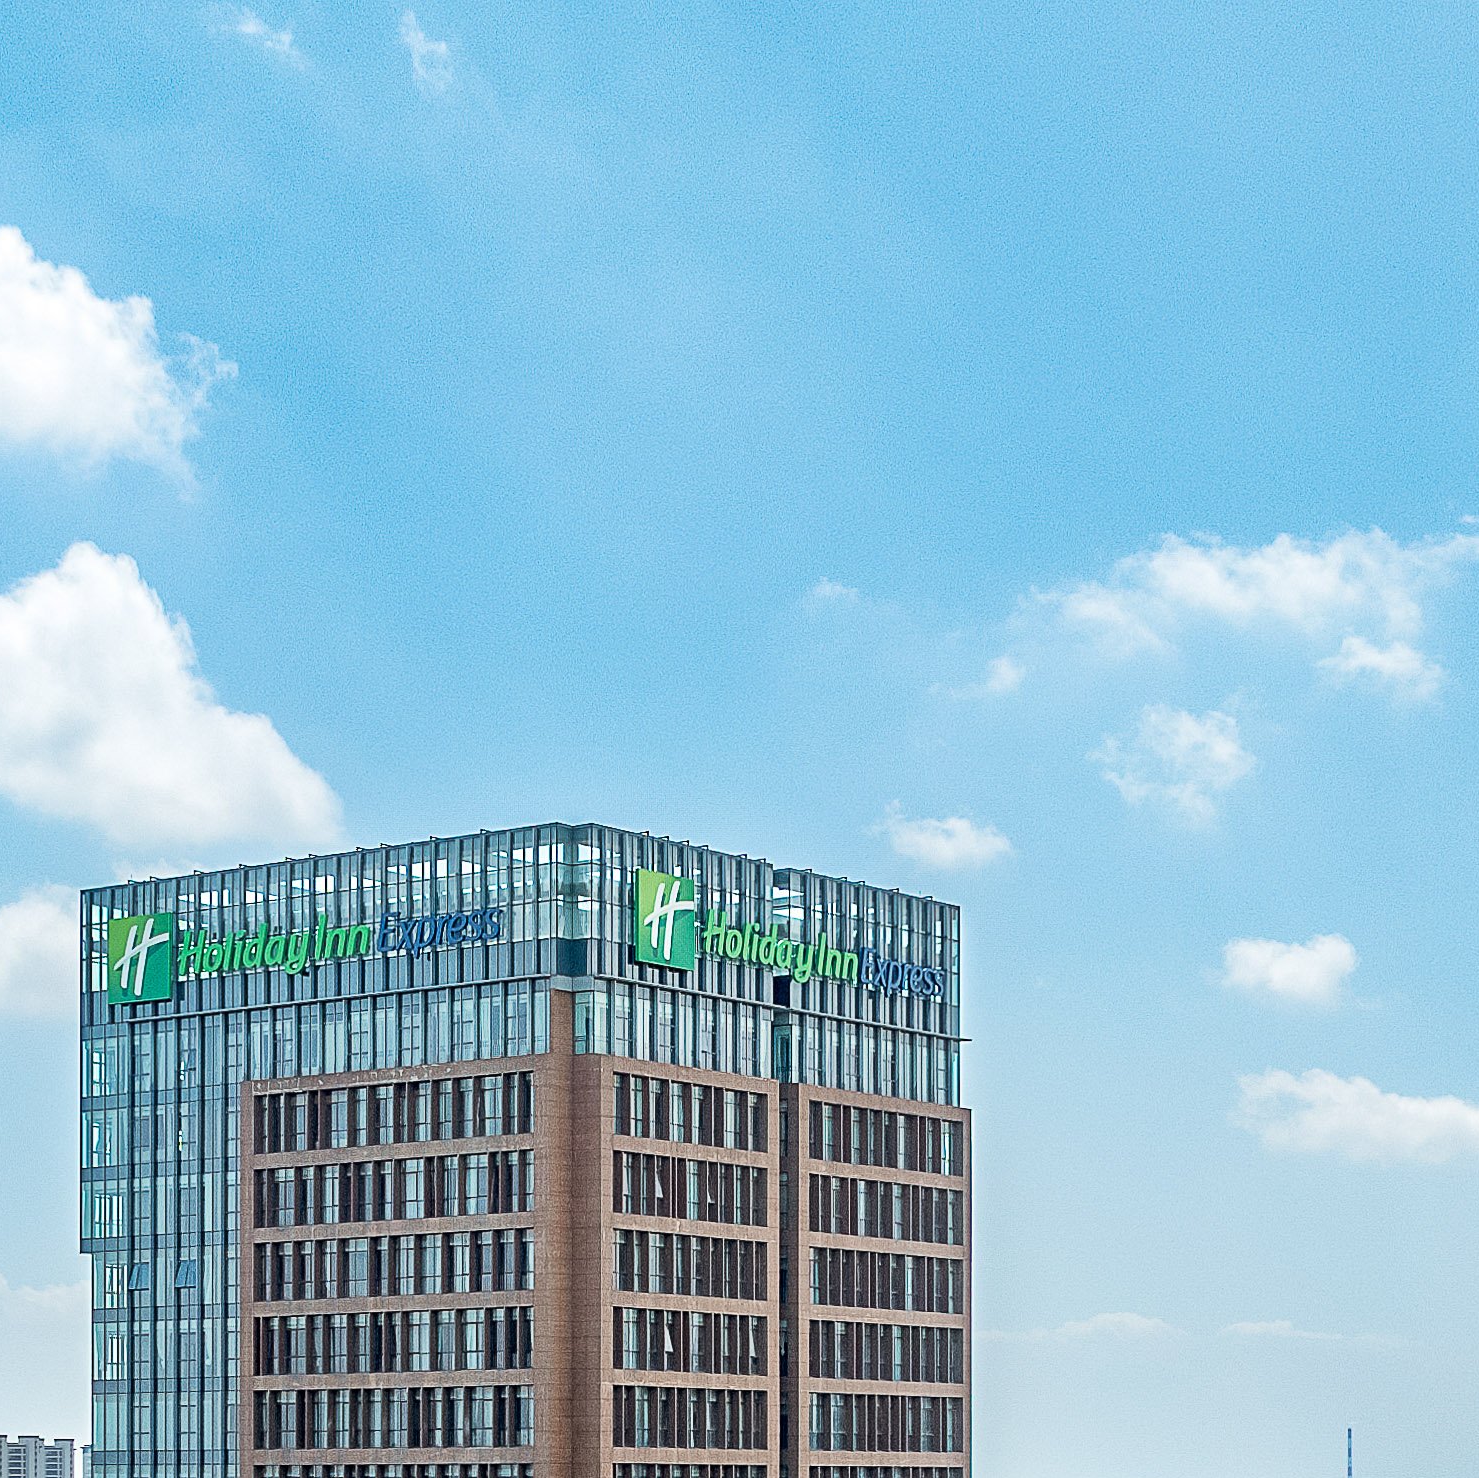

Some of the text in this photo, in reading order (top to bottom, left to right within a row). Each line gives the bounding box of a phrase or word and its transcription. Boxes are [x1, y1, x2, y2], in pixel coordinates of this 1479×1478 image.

[178, 922, 310, 975] Holiday
[314, 914, 372, 957] Inn
[377, 908, 502, 959] Express
[703, 909, 815, 983] Holiday
[818, 932, 858, 980] Inn
[860, 947, 944, 997] Express
